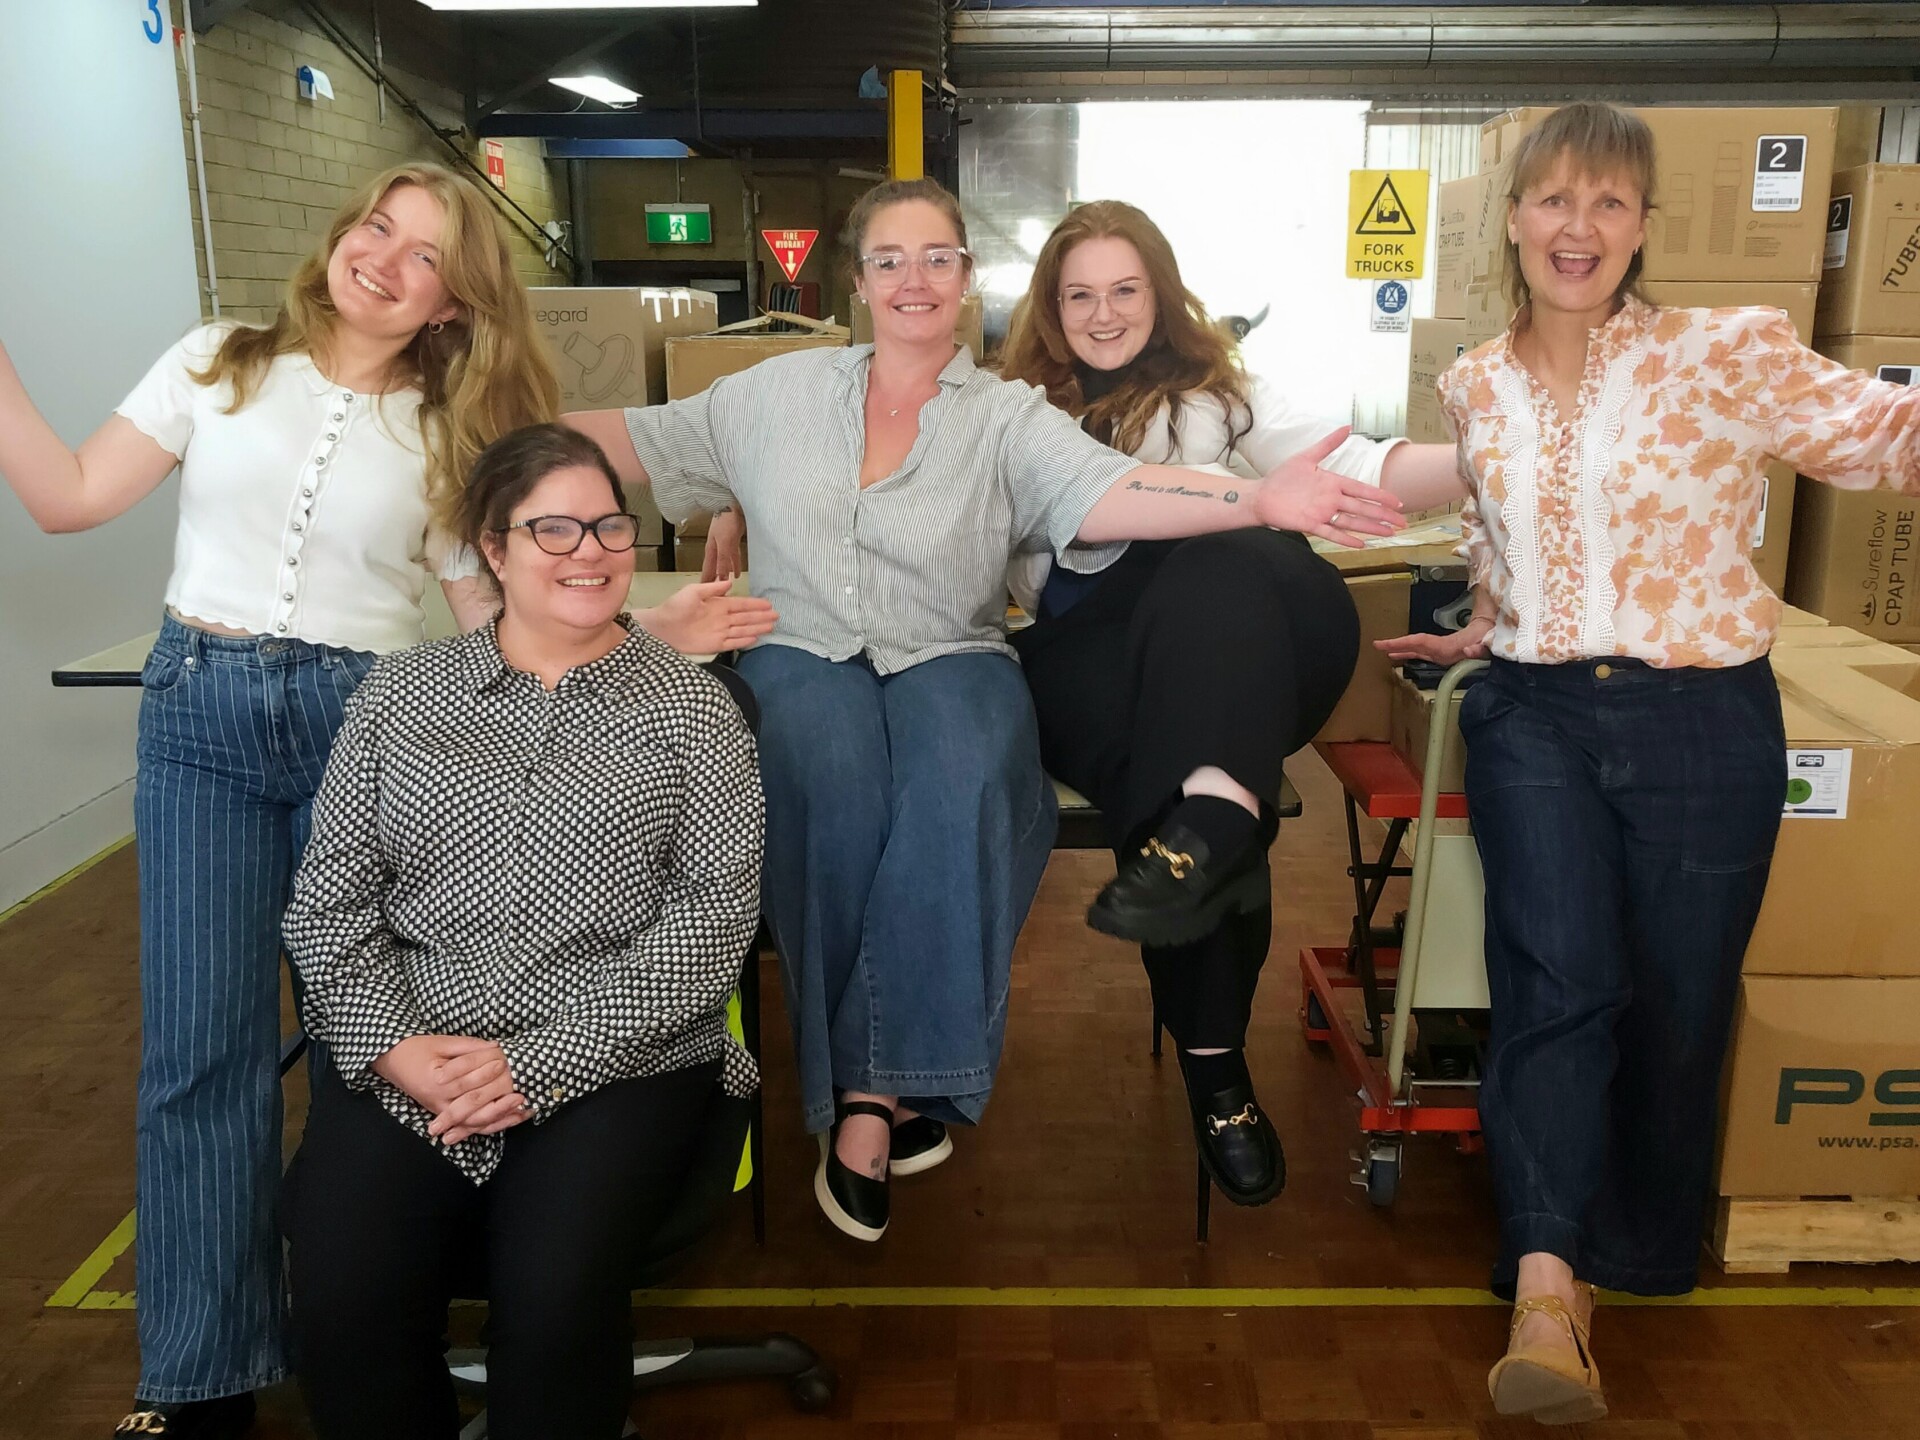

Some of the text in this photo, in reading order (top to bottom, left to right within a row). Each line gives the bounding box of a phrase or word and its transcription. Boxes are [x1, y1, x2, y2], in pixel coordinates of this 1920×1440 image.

[1769, 142, 1788, 168] 2
[1831, 203, 1842, 228] 2
[782, 232, 799, 240] FIRE
[1363, 243, 1405, 255] FORK
[1882, 224, 1920, 287] TUBE
[1354, 260, 1415, 273] TRUCKS
[535, 307, 589, 326] egard
[1862, 509, 1888, 591] Sureflow
[1884, 510, 1915, 626] CPAP TUBE
